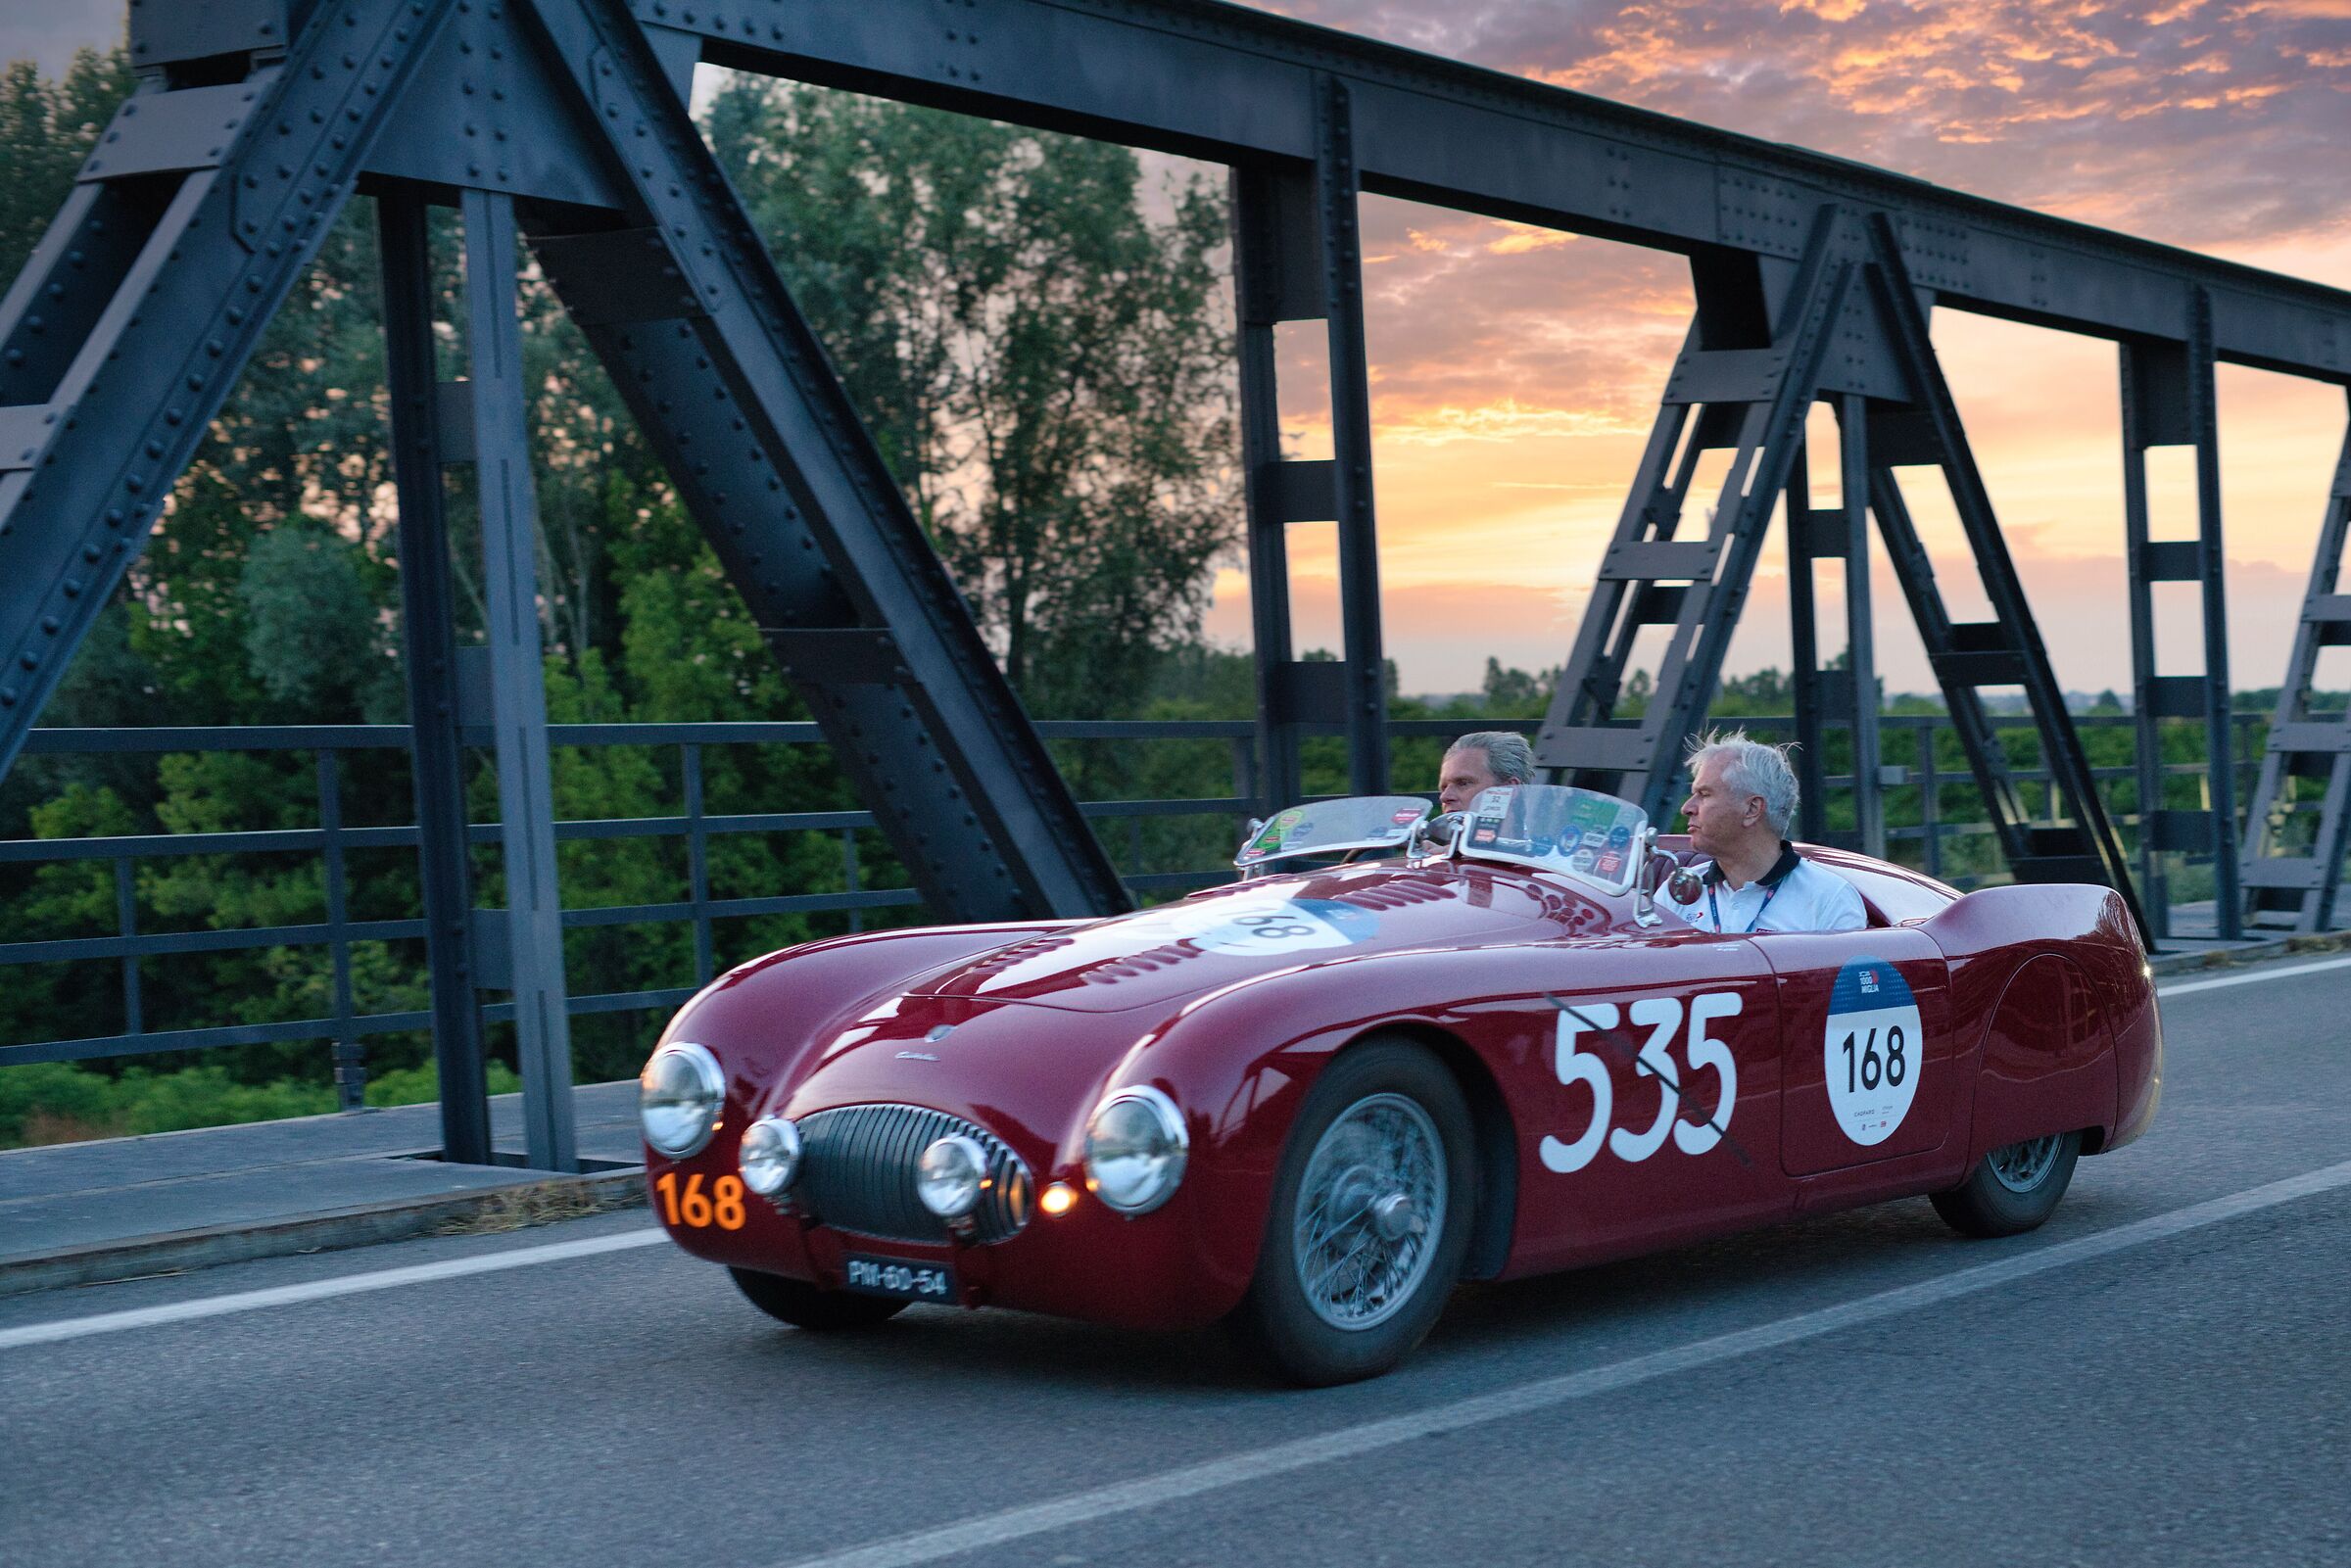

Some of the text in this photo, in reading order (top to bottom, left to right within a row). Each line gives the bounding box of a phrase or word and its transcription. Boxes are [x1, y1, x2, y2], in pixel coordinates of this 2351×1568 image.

[1539, 991, 1743, 1173] 535
[1843, 1024, 1905, 1093] 168
[656, 1172, 746, 1231] 168
